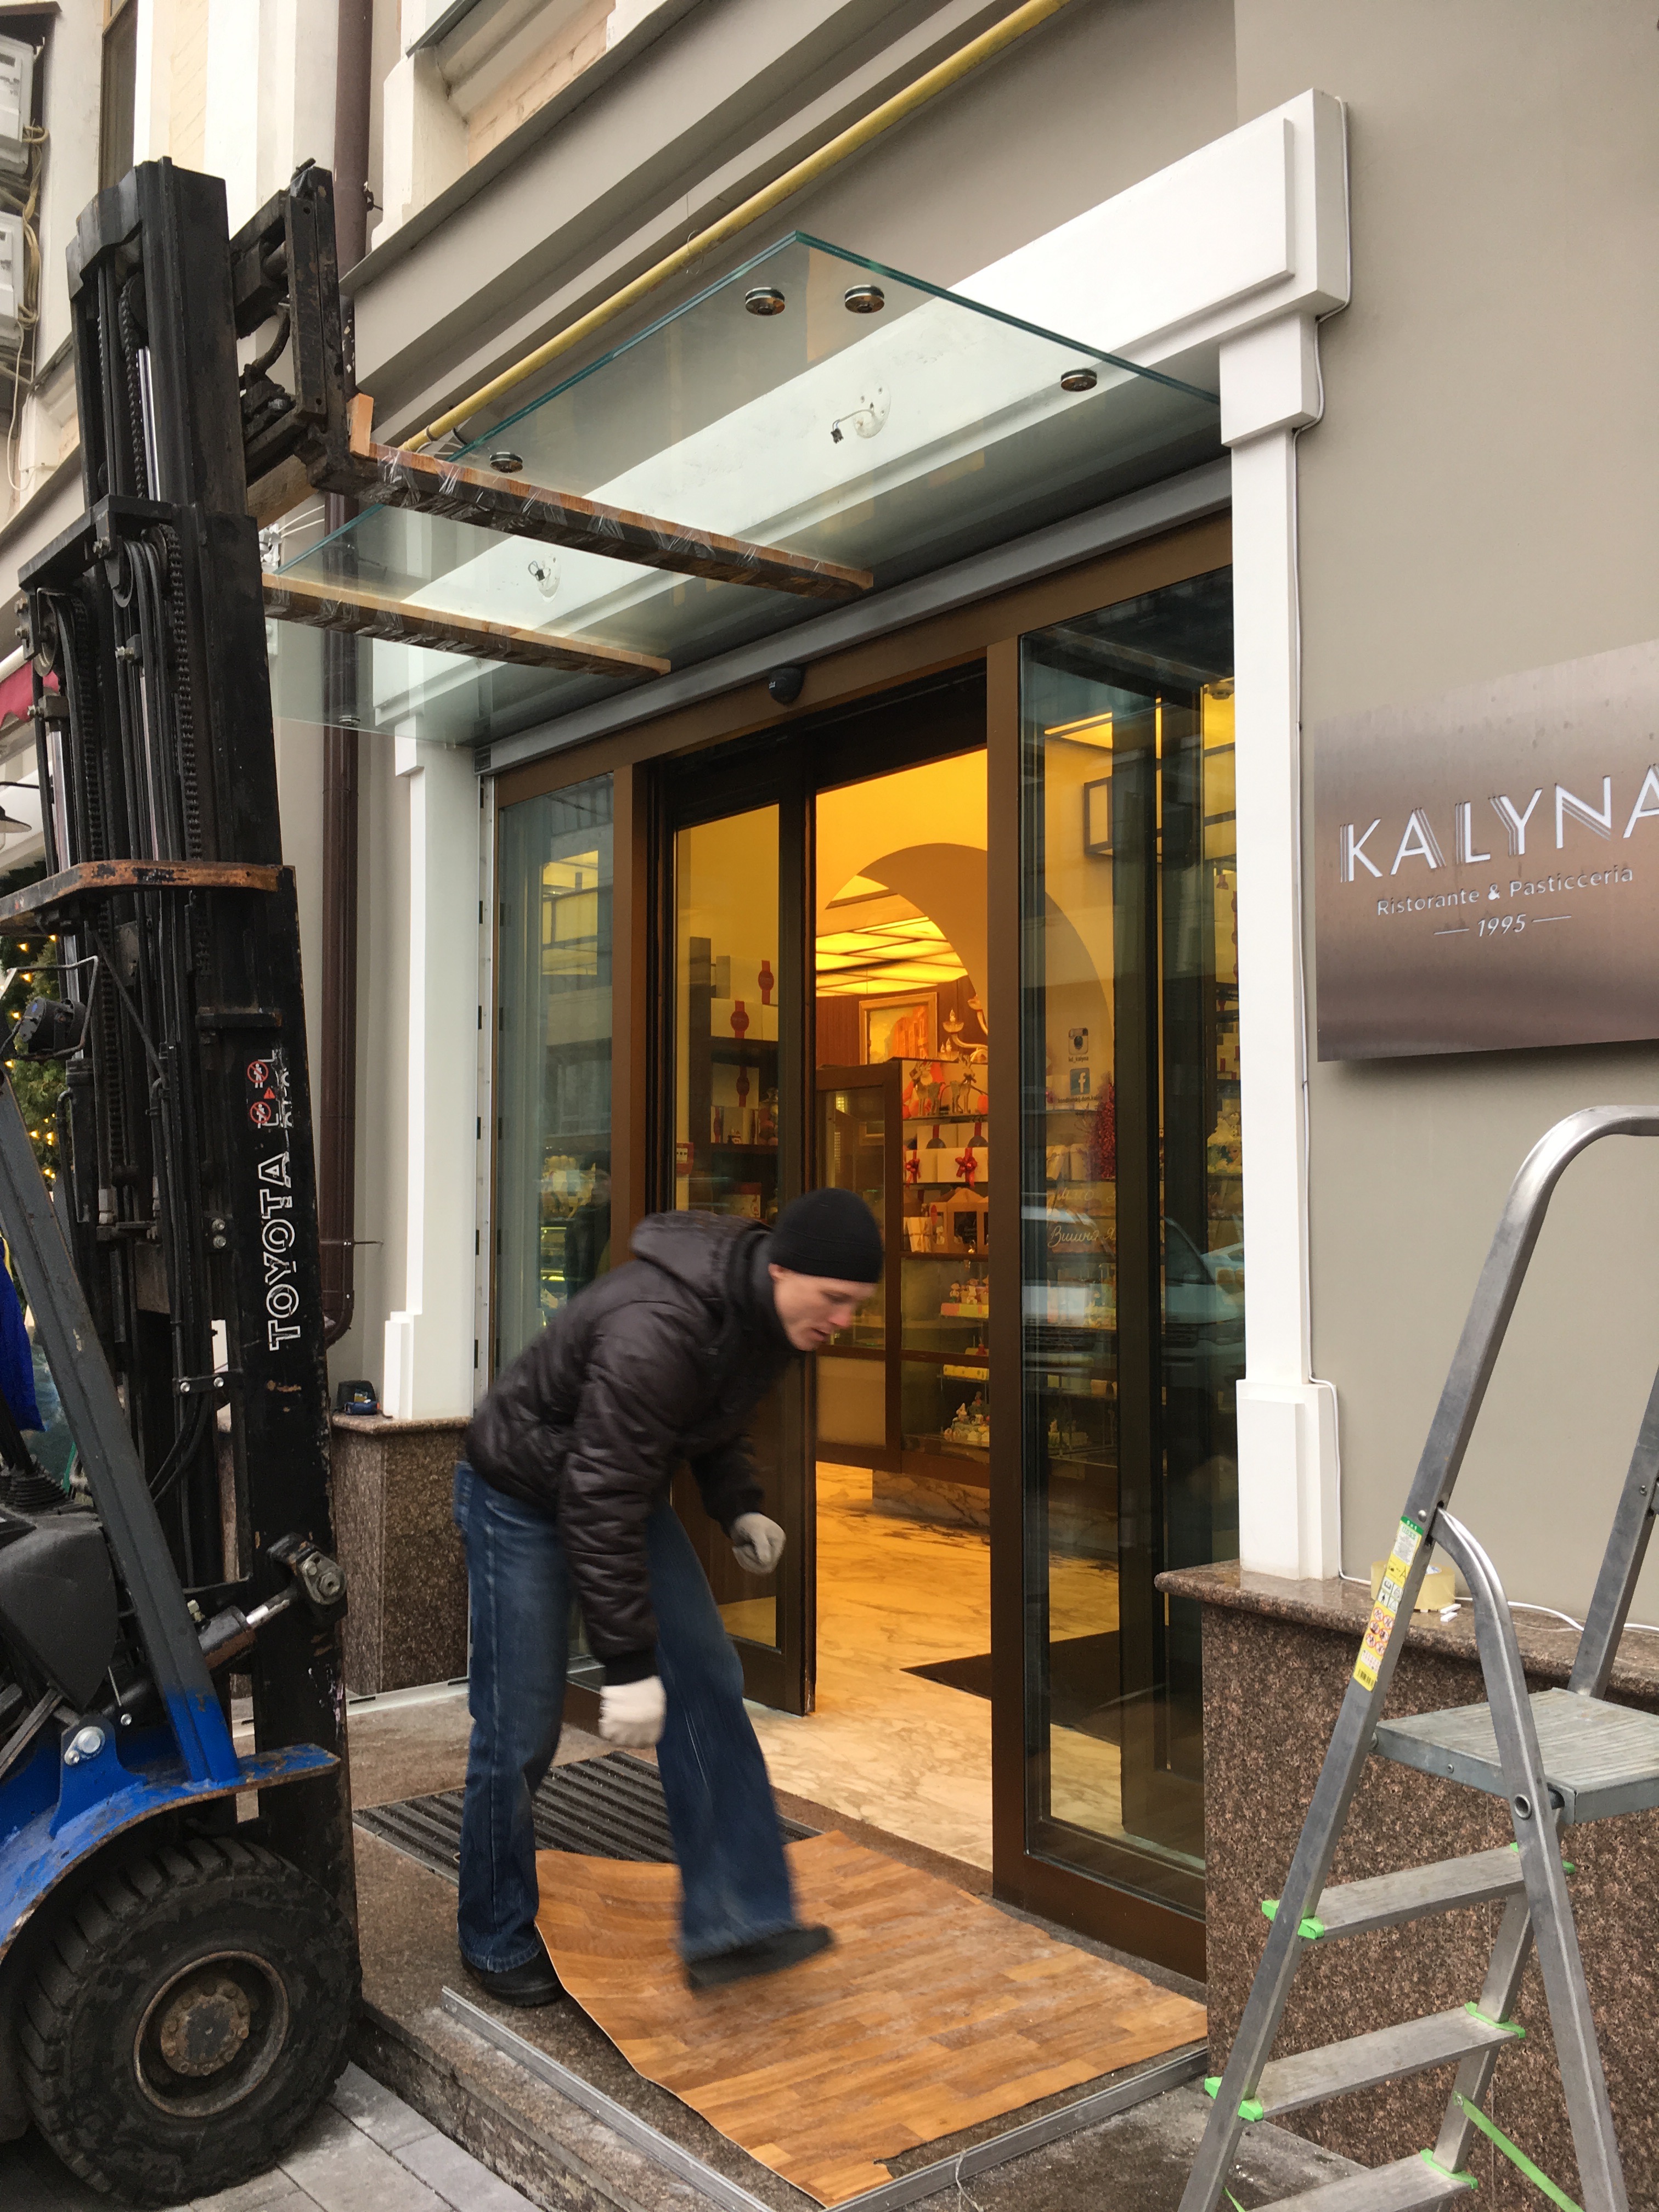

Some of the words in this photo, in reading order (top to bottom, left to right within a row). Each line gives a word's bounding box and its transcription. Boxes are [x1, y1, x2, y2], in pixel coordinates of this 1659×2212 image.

[1339, 764, 1659, 883] KALYNA
[1377, 888, 1480, 916] Ristorante
[1488, 884, 1501, 900] &
[1509, 865, 1633, 896] Pasticceria
[1477, 913, 1527, 937] 1995
[258, 1152, 301, 1351] TOYOTA
